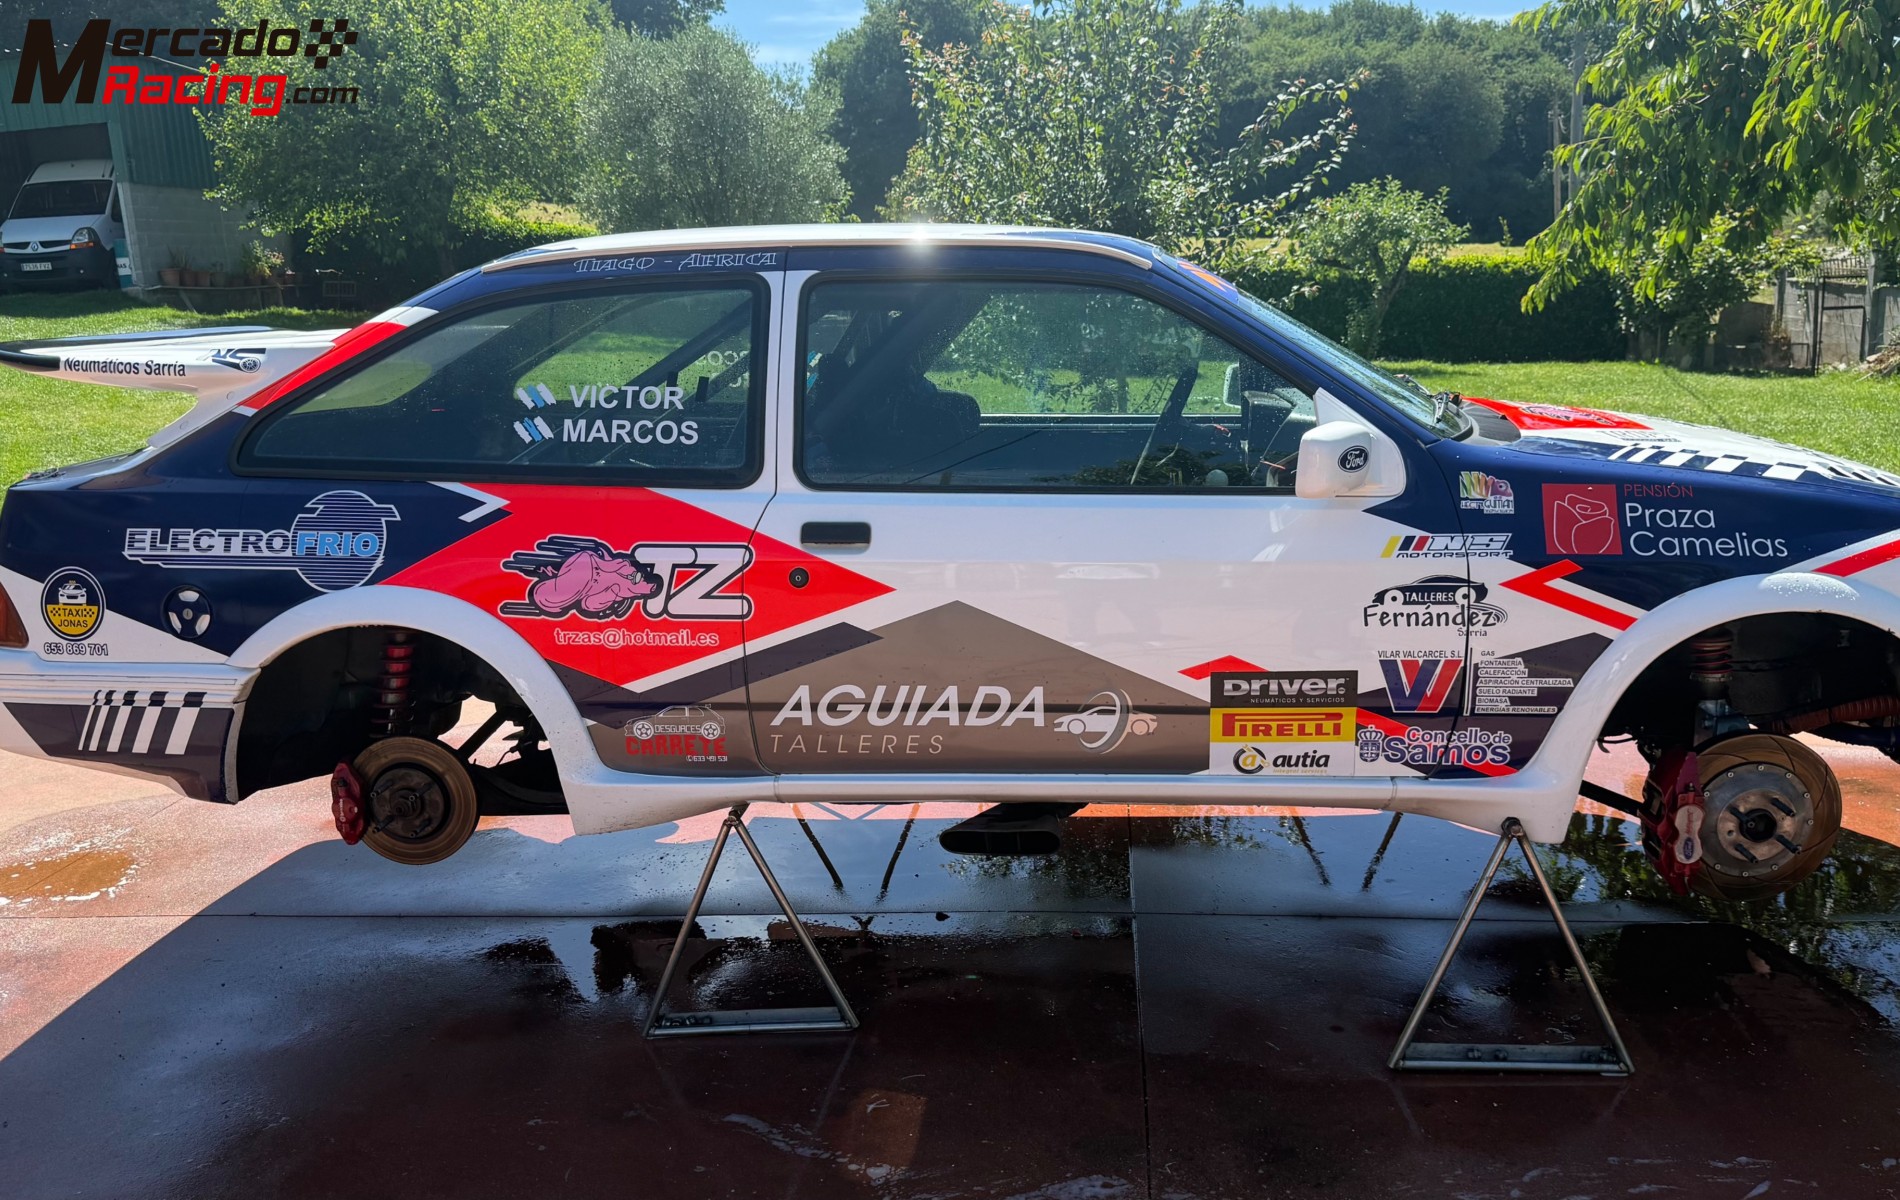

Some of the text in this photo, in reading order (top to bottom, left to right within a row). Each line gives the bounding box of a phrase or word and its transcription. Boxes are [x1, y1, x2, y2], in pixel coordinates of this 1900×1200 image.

[64, 357, 140, 375] Neumáticos
[570, 385, 684, 410] VICTOR
[562, 419, 699, 445] MARCOS
[1346, 451, 1365, 468] Ford
[1624, 483, 1694, 498] PENSIÓN
[1624, 502, 1716, 529] Praza
[1629, 531, 1788, 558] Camelias
[1396, 551, 1513, 559] MOTORSPORT
[632, 544, 754, 619] TZ
[1404, 591, 1455, 602] TALLERES
[62, 607, 85, 617] TAXI
[1363, 603, 1498, 628] Fernández
[58, 618, 89, 629] JONAS
[554, 628, 719, 648] trzas@hotmail.es
[44, 642, 109, 656] 653 869 701
[1378, 650, 1400, 659] VILAR
[1402, 650, 1448, 659] VALCARCEL
[1521, 676, 1572, 686] CENTRALIZADA
[1477, 686, 1535, 695] SUELO RADIANTE
[770, 685, 1045, 726] AGUIADA
[1477, 695, 1509, 704] BIOMASA
[1513, 704, 1555, 713] RENOVABLES
[655, 724, 701, 733] DESGUACES
[1222, 713, 1344, 736] PIRELLI
[1406, 727, 1511, 744] Concello de
[626, 735, 726, 755] CARRETE
[770, 735, 943, 754] TALLERES
[1384, 736, 1511, 764] Samos
[1273, 750, 1330, 768] autia
